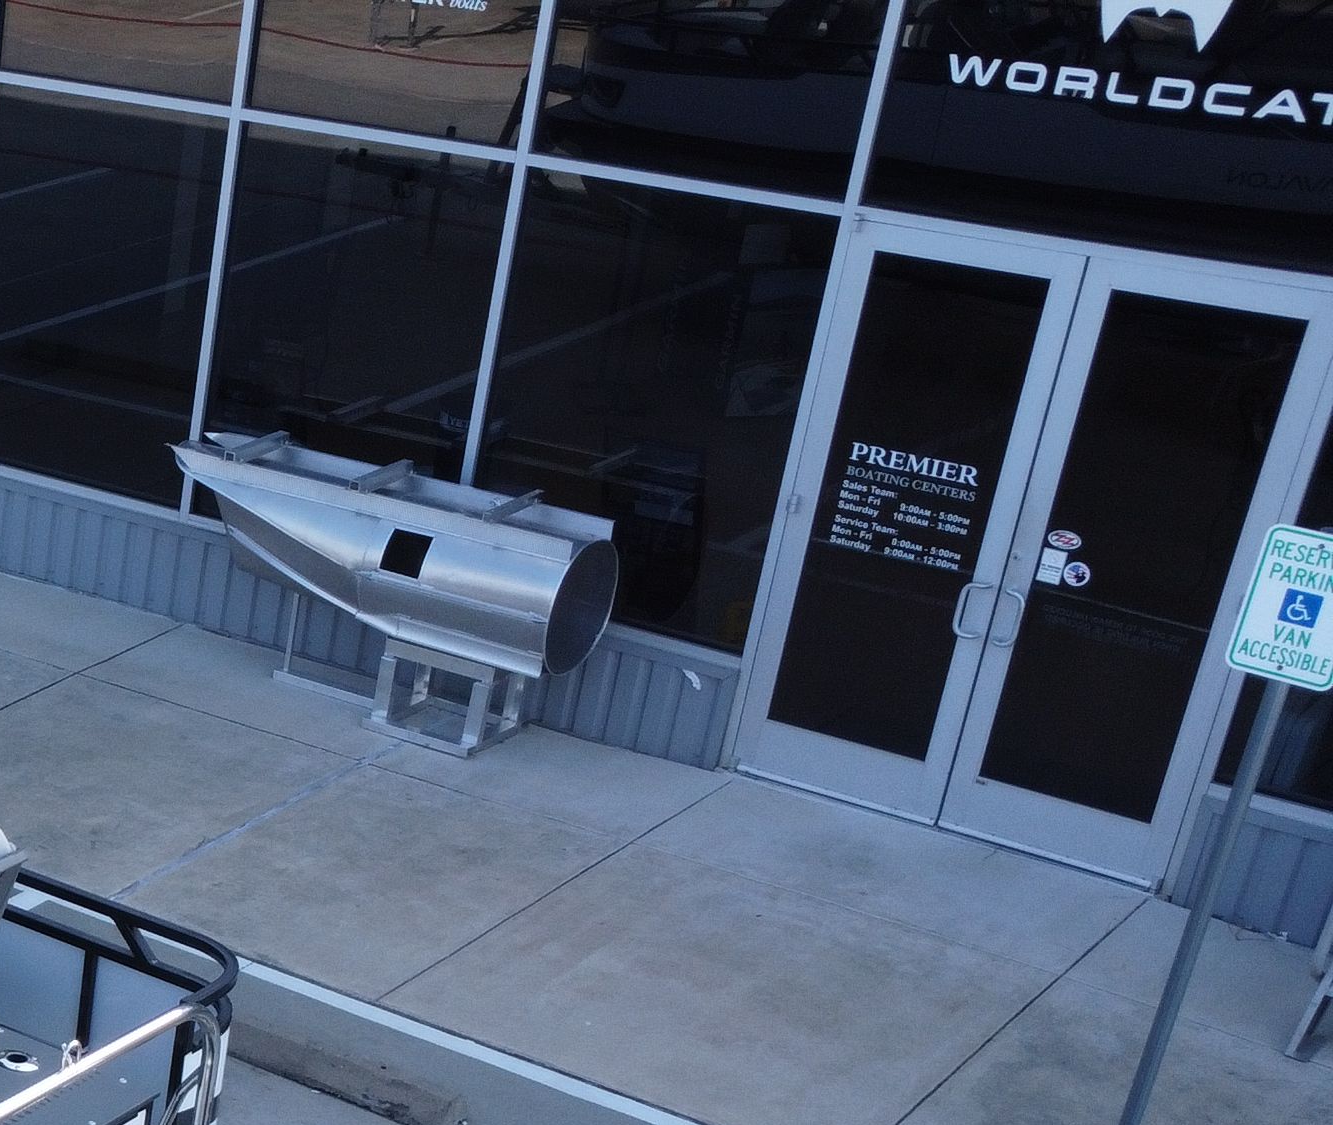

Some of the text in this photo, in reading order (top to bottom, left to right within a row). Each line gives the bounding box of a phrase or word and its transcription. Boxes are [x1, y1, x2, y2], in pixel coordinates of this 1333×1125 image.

[948, 53, 1333, 126] WORLDCAT
[848, 441, 979, 487] PREMIER
[842, 479, 899, 499] Sales Team:
[845, 465, 976, 502] BOATING CENTERS
[837, 500, 879, 518] Saturday
[839, 489, 861, 502] Mon
[867, 496, 881, 506] Fri
[832, 524, 852, 536] Mon
[859, 530, 873, 540] Fri
[834, 514, 899, 536] Service Team:
[829, 534, 872, 553] Saturday
[1270, 539, 1333, 569] RESER
[1273, 624, 1312, 650] VAN
[1238, 638, 1331, 677] ACCESSIBLE
